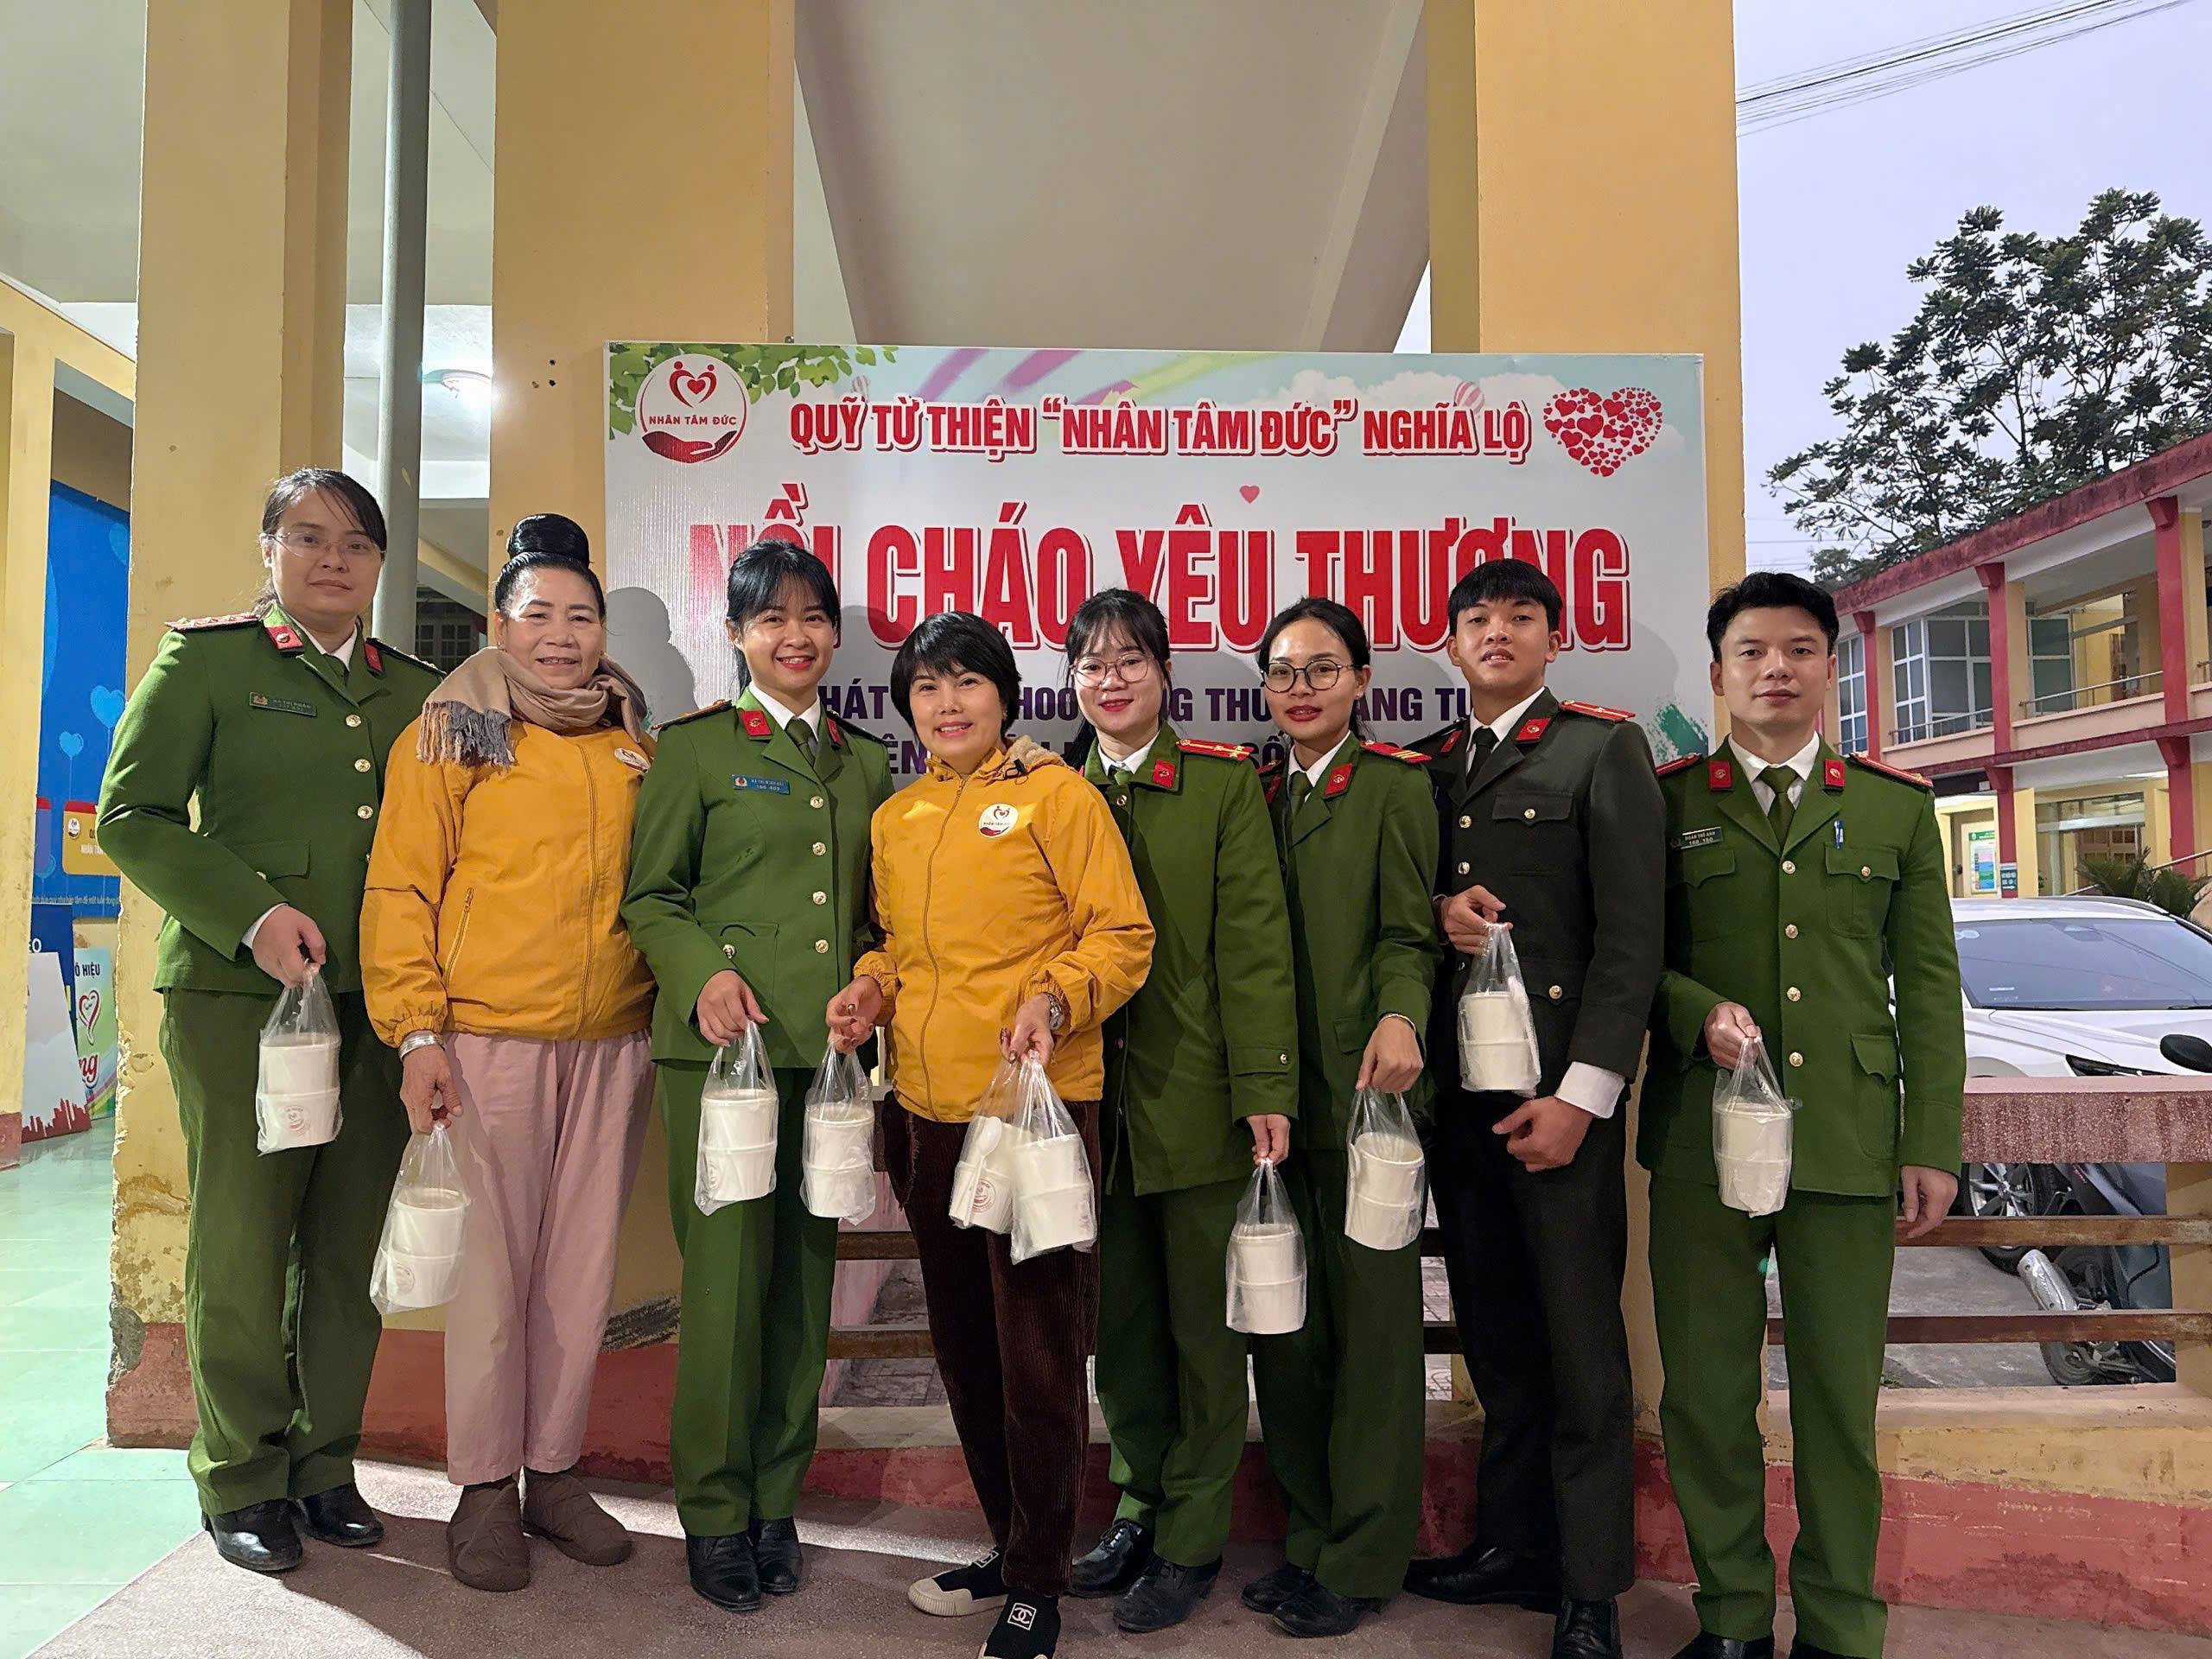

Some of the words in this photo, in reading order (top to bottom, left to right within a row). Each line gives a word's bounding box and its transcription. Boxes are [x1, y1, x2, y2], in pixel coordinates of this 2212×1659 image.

[649, 414, 681, 425] NHÂN
[684, 414, 708, 425] TÂM
[712, 414, 737, 425] ĐỨC
[790, 396, 862, 448] QUỸ
[872, 396, 920, 445] TỪ
[926, 398, 1032, 457] THIỆN
[1042, 397, 1163, 449] “NHÂN
[1173, 400, 1250, 450] TÂM
[1260, 400, 1352, 450] ĐỨC”
[1363, 402, 1474, 450] NGHĨA
[1484, 401, 1526, 458] LỘ
[867, 501, 1089, 646] CHÁO
[1115, 504, 1269, 647] YÊU
[82, 961, 101, 979] HIỆU
